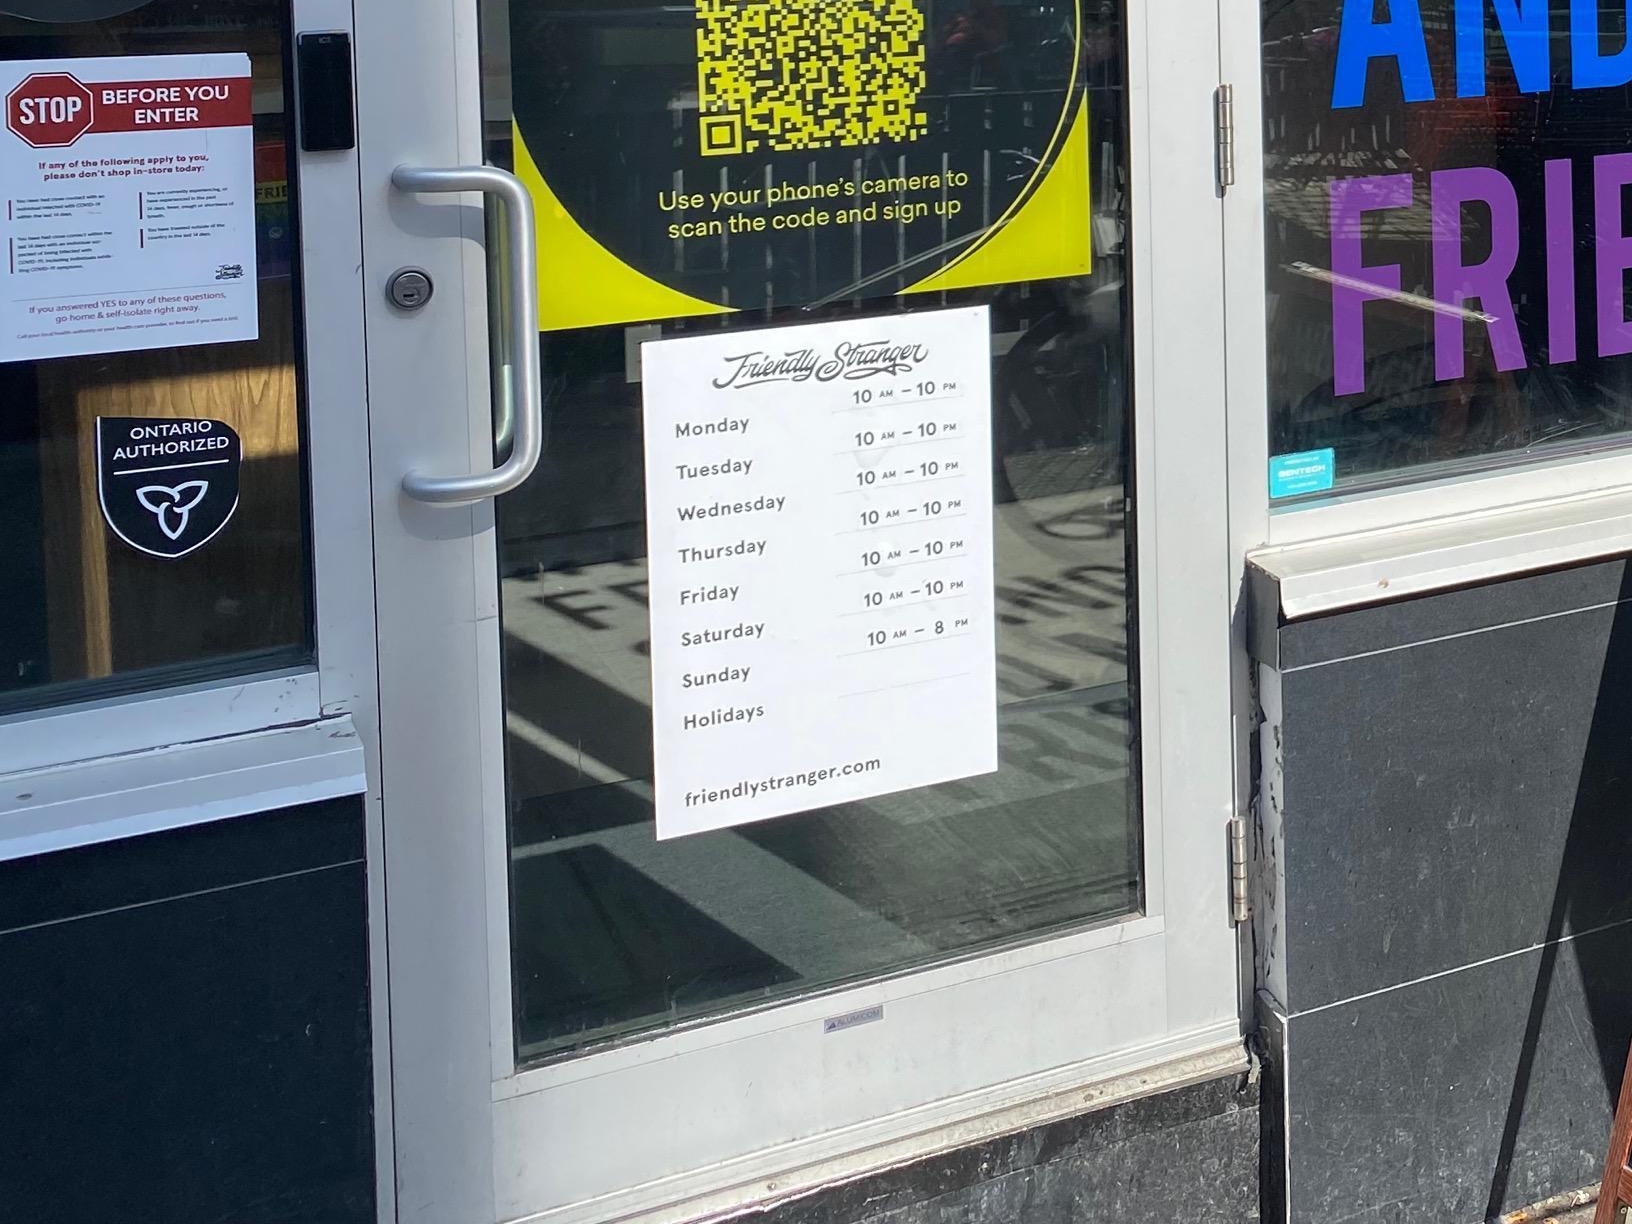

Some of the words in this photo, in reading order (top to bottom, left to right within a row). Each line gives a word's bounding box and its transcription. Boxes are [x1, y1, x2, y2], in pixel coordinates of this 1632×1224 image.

[102, 87, 181, 105] BEFORE
[184, 85, 229, 101] YOU
[19, 96, 82, 125] STOP
[134, 107, 199, 124] ENTER
[38, 162, 46, 170] If
[48, 162, 66, 170] any
[68, 160, 79, 168] of
[100, 157, 145, 166] following
[147, 156, 174, 165] apply
[188, 155, 209, 163] you,
[44, 172, 76, 181] please
[78, 169, 105, 178] don't
[107, 169, 131, 178] shop
[133, 167, 173, 175] in-store
[175, 165, 205, 173] today:
[658, 189, 705, 212] Use
[710, 187, 761, 212] your
[766, 176, 856, 208] phone's
[860, 173, 941, 196] camera
[945, 170, 968, 188] to
[668, 215, 723, 239] scan
[728, 211, 766, 234] the
[771, 206, 829, 230] code
[835, 200, 877, 225] and
[882, 198, 928, 225] sign
[934, 199, 961, 219] up
[55, 316, 68, 324] go
[70, 313, 96, 322] home
[97, 311, 104, 319] &
[106, 307, 152, 318] self-isolate
[154, 305, 174, 315] right
[177, 304, 200, 313] away.
[56, 301, 99, 312] answered
[100, 300, 116, 308] YES
[147, 296, 156, 304] of
[158, 294, 181, 303] these
[183, 292, 227, 302] questions,
[712, 349, 820, 389] Friendly
[815, 340, 929, 382] Stranger
[853, 389, 872, 404] 10
[880, 390, 893, 398] AM
[916, 381, 935, 396] 10
[943, 382, 956, 390] PM
[129, 420, 212, 440] ONTARIO
[675, 417, 750, 438] Monday
[855, 431, 874, 447] 10
[881, 431, 895, 440] AM
[918, 422, 936, 437] 10
[943, 423, 957, 431] PM
[112, 436, 230, 461] AUTHORIZED
[676, 458, 753, 480] Tuesday
[857, 470, 875, 486] 10
[882, 470, 896, 479] AM
[920, 461, 938, 476] 10
[945, 462, 958, 470] PM
[677, 496, 786, 521] Wednesday
[860, 510, 879, 526] 10
[885, 509, 900, 518] AM
[923, 501, 941, 516] 10
[948, 500, 961, 508] PM
[678, 539, 767, 564] Thursday
[861, 551, 880, 566] 10
[888, 550, 901, 559] AM
[924, 541, 943, 556] 10
[950, 540, 963, 549] PM
[680, 583, 740, 605] Friday
[864, 592, 882, 607] 10
[889, 591, 903, 600] AM
[925, 580, 943, 596] 10
[950, 581, 964, 589] PM
[681, 622, 766, 647] Saturday
[867, 631, 886, 646] 10
[893, 630, 907, 639] AM
[934, 620, 944, 634] 8
[955, 618, 968, 627] PM
[682, 666, 751, 689] Sunday
[683, 704, 765, 730] Holidays
[685, 758, 881, 807] friendlystranger.com
